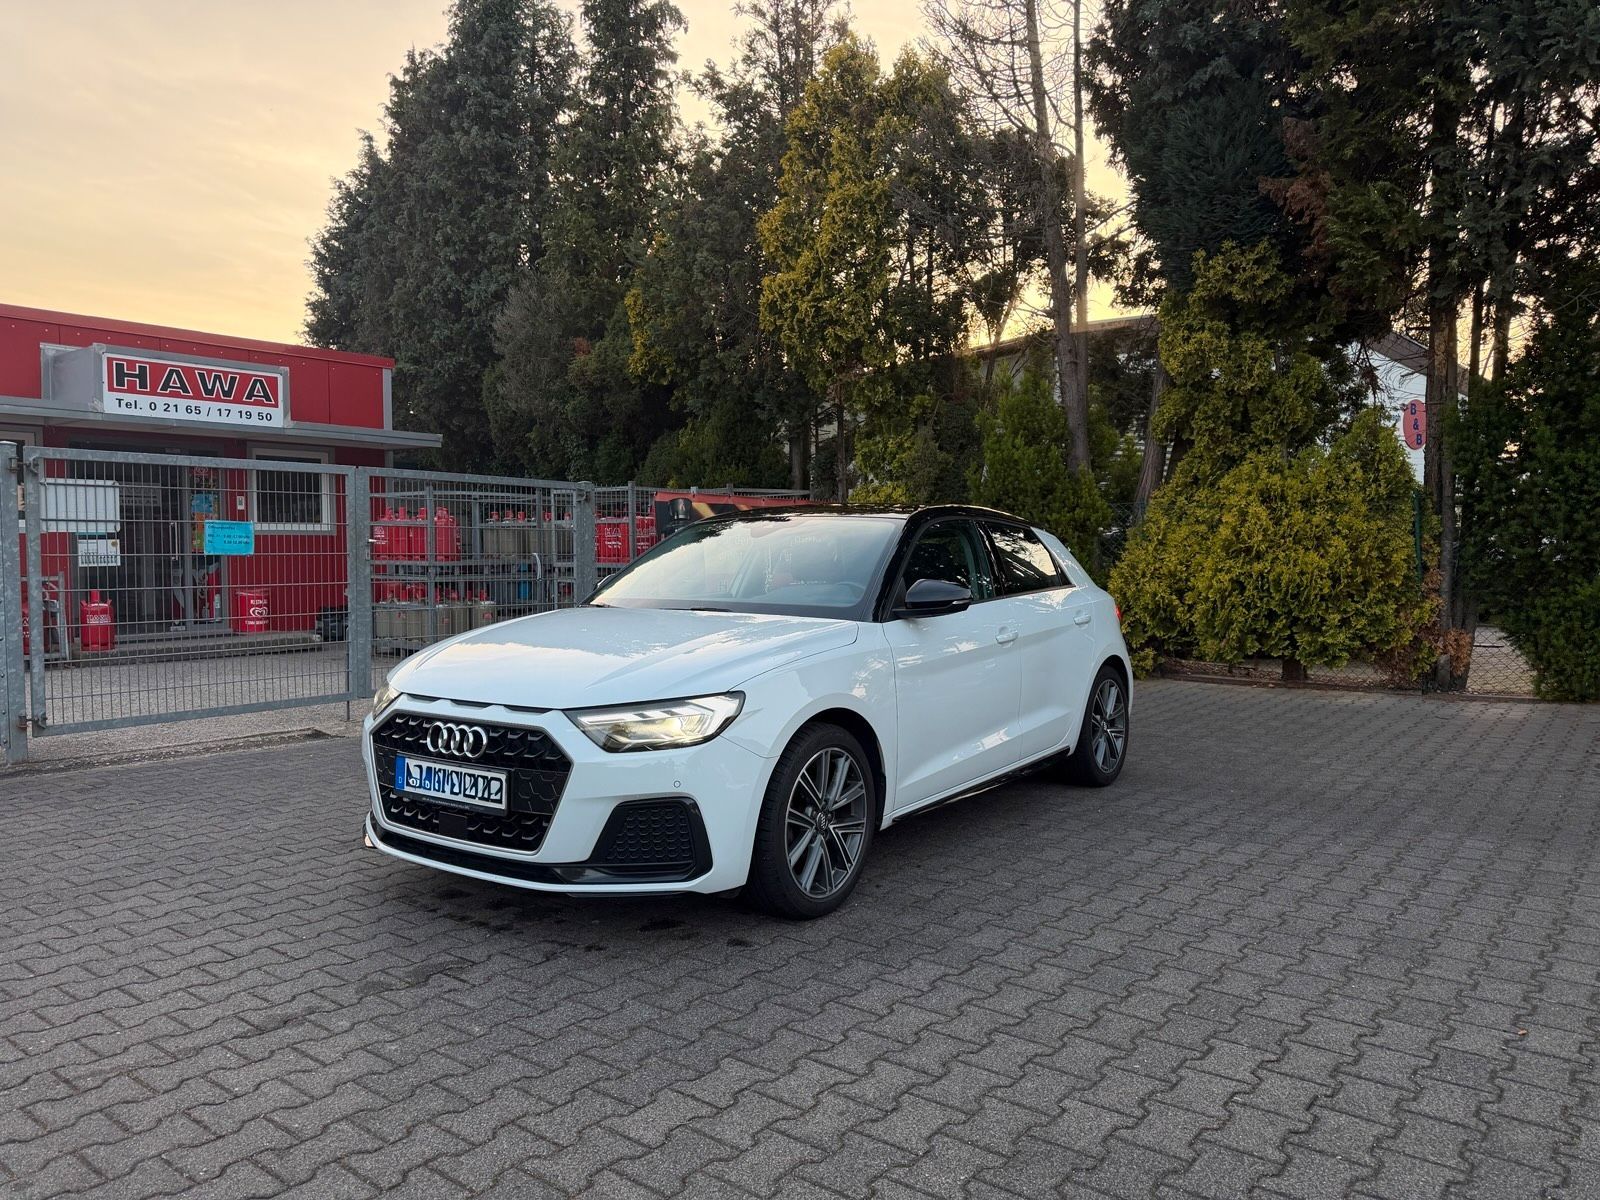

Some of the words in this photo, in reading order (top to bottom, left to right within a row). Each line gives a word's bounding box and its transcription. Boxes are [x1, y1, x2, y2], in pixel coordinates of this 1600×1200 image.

[113, 361, 275, 404] HAWA
[116, 398, 143, 410] Tel.
[149, 402, 157, 411] 0
[163, 403, 178, 413] 21
[185, 405, 201, 415] 65
[217, 408, 231, 418] 17
[238, 410, 252, 420] 19
[257, 412, 273, 422] 50
